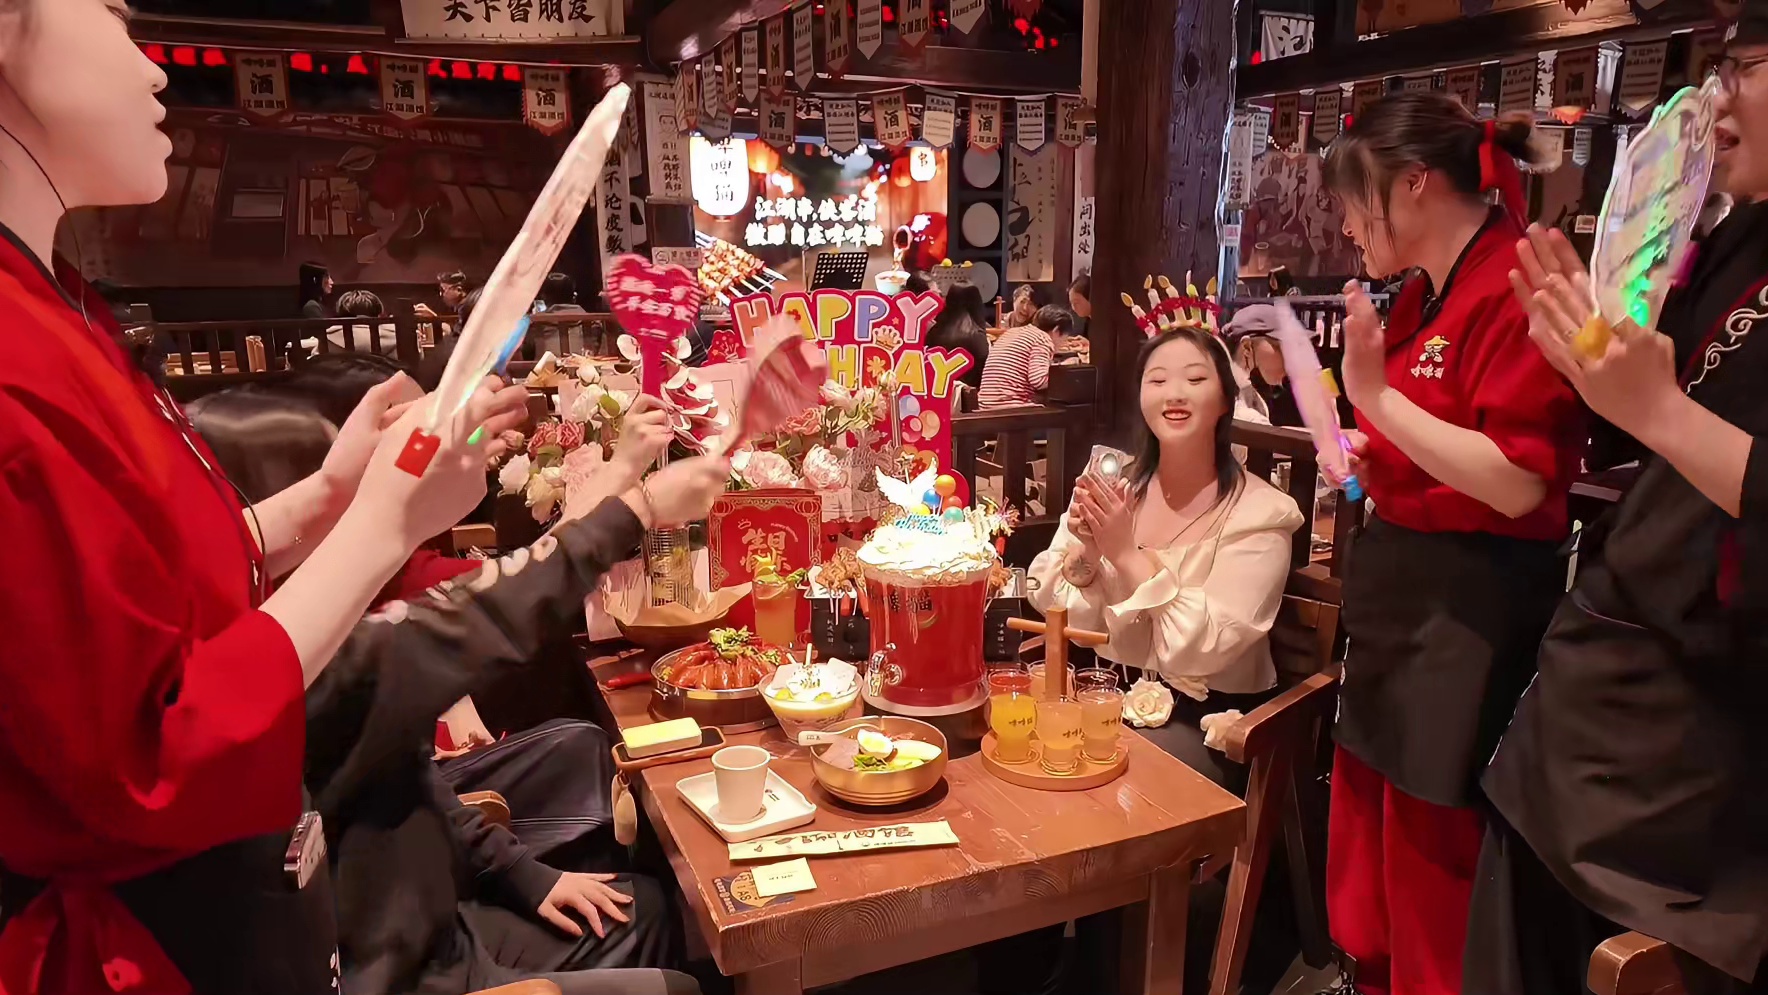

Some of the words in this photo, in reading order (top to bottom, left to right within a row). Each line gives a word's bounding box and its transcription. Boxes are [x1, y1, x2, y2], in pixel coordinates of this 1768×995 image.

[250, 72, 274, 95] 酒
[393, 79, 415, 100] 酒
[1565, 72, 1585, 95] 酒
[535, 87, 556, 108] 酒
[769, 110, 786, 130] 酒
[883, 109, 900, 129] 酒
[978, 114, 993, 133] 酒
[1078, 197, 1093, 254] 问出处
[734, 293, 939, 347] HAPPY
[825, 345, 971, 398] HDAY
[741, 527, 787, 552] 生日
